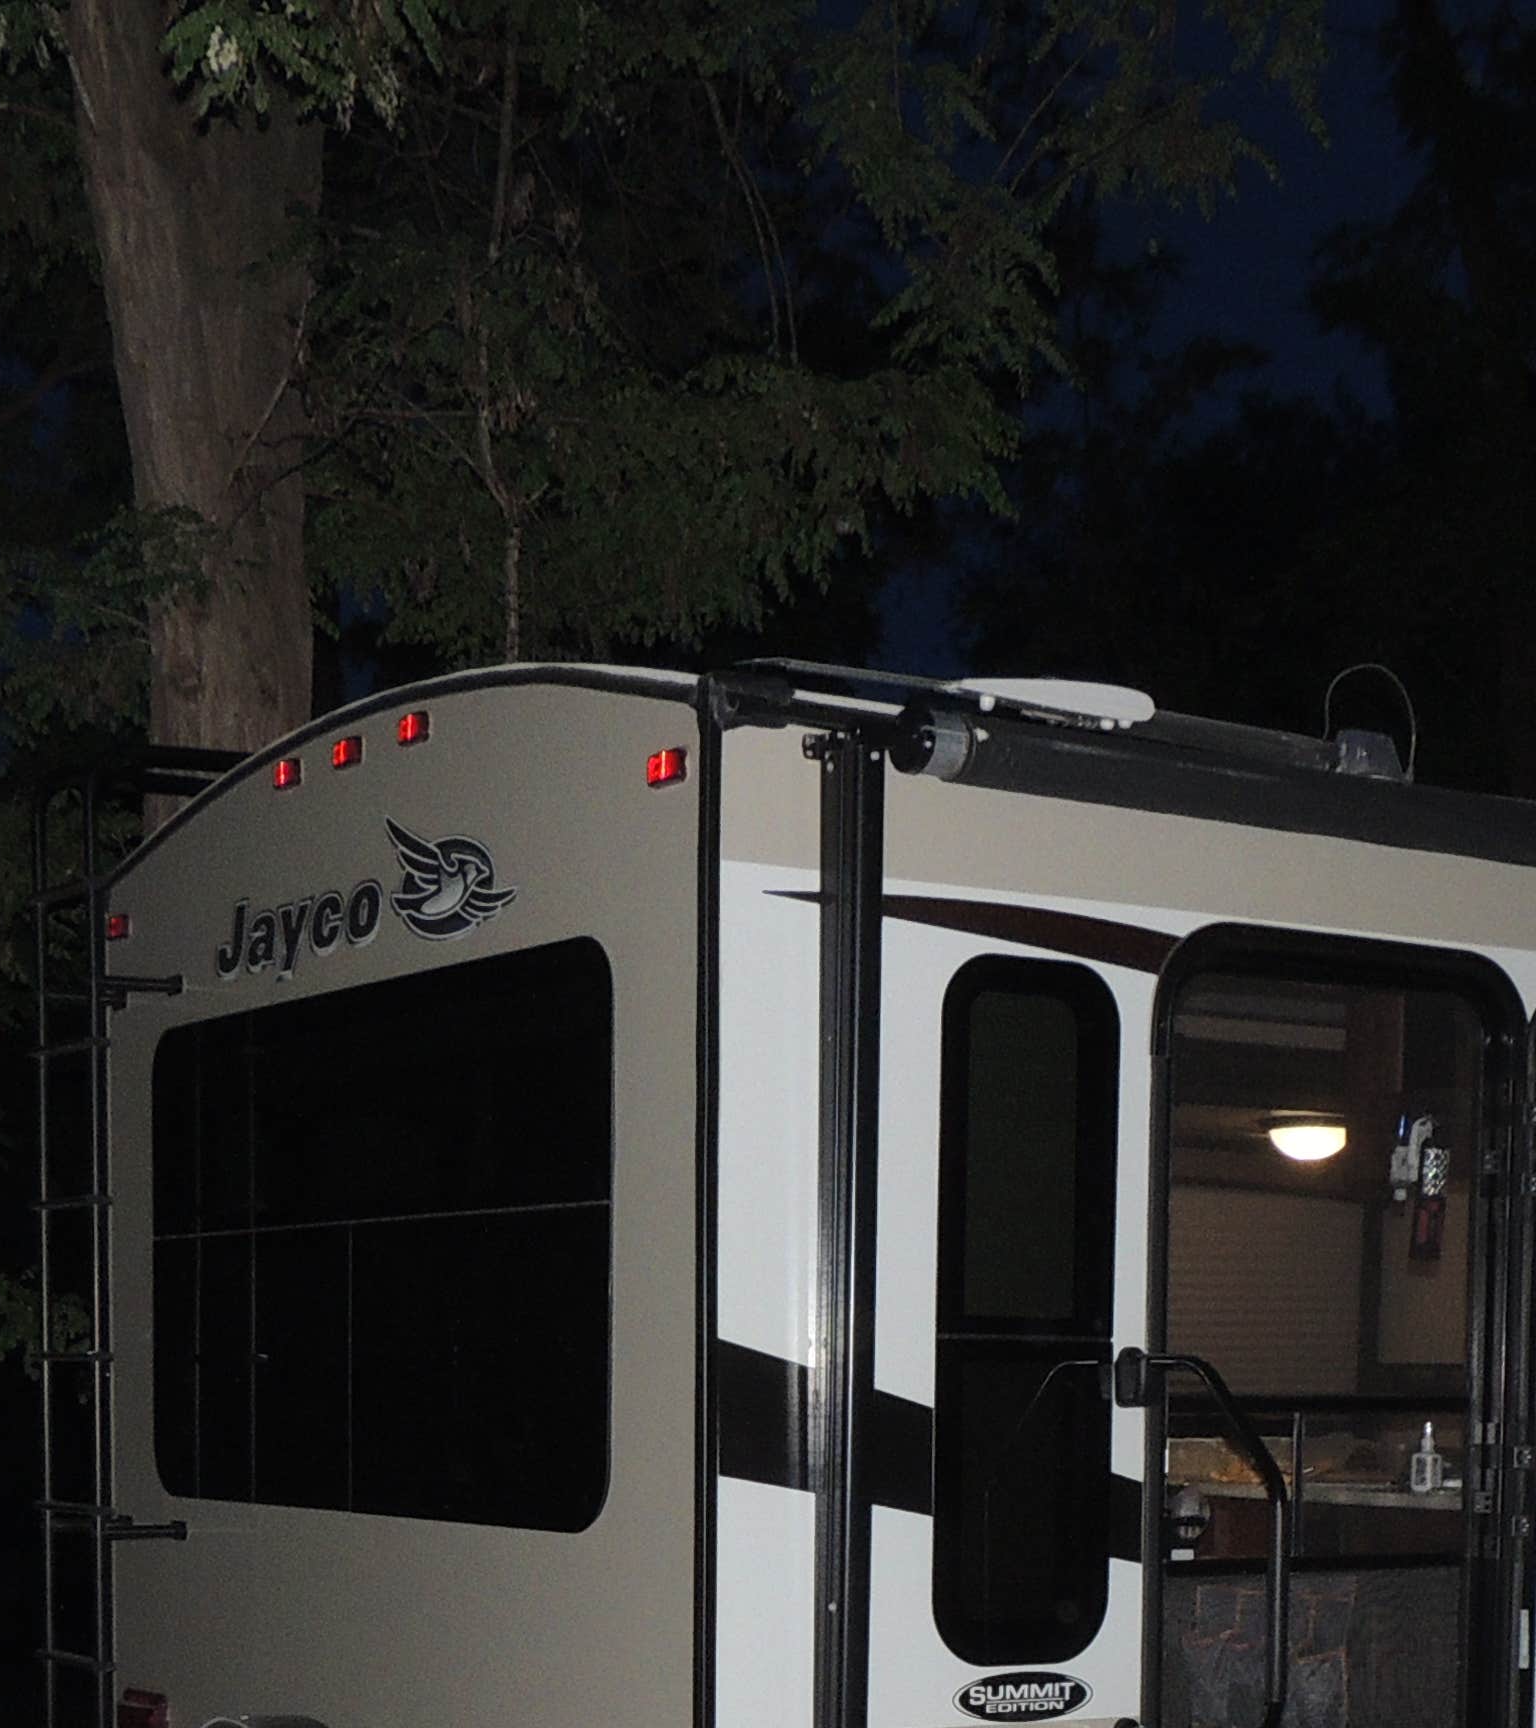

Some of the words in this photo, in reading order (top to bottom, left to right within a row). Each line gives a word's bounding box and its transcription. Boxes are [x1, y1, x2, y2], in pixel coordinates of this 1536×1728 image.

[216, 879, 383, 982] Jayco
[969, 1682, 1076, 1706] SUMMIT
[985, 1700, 1065, 1714] EDITION
